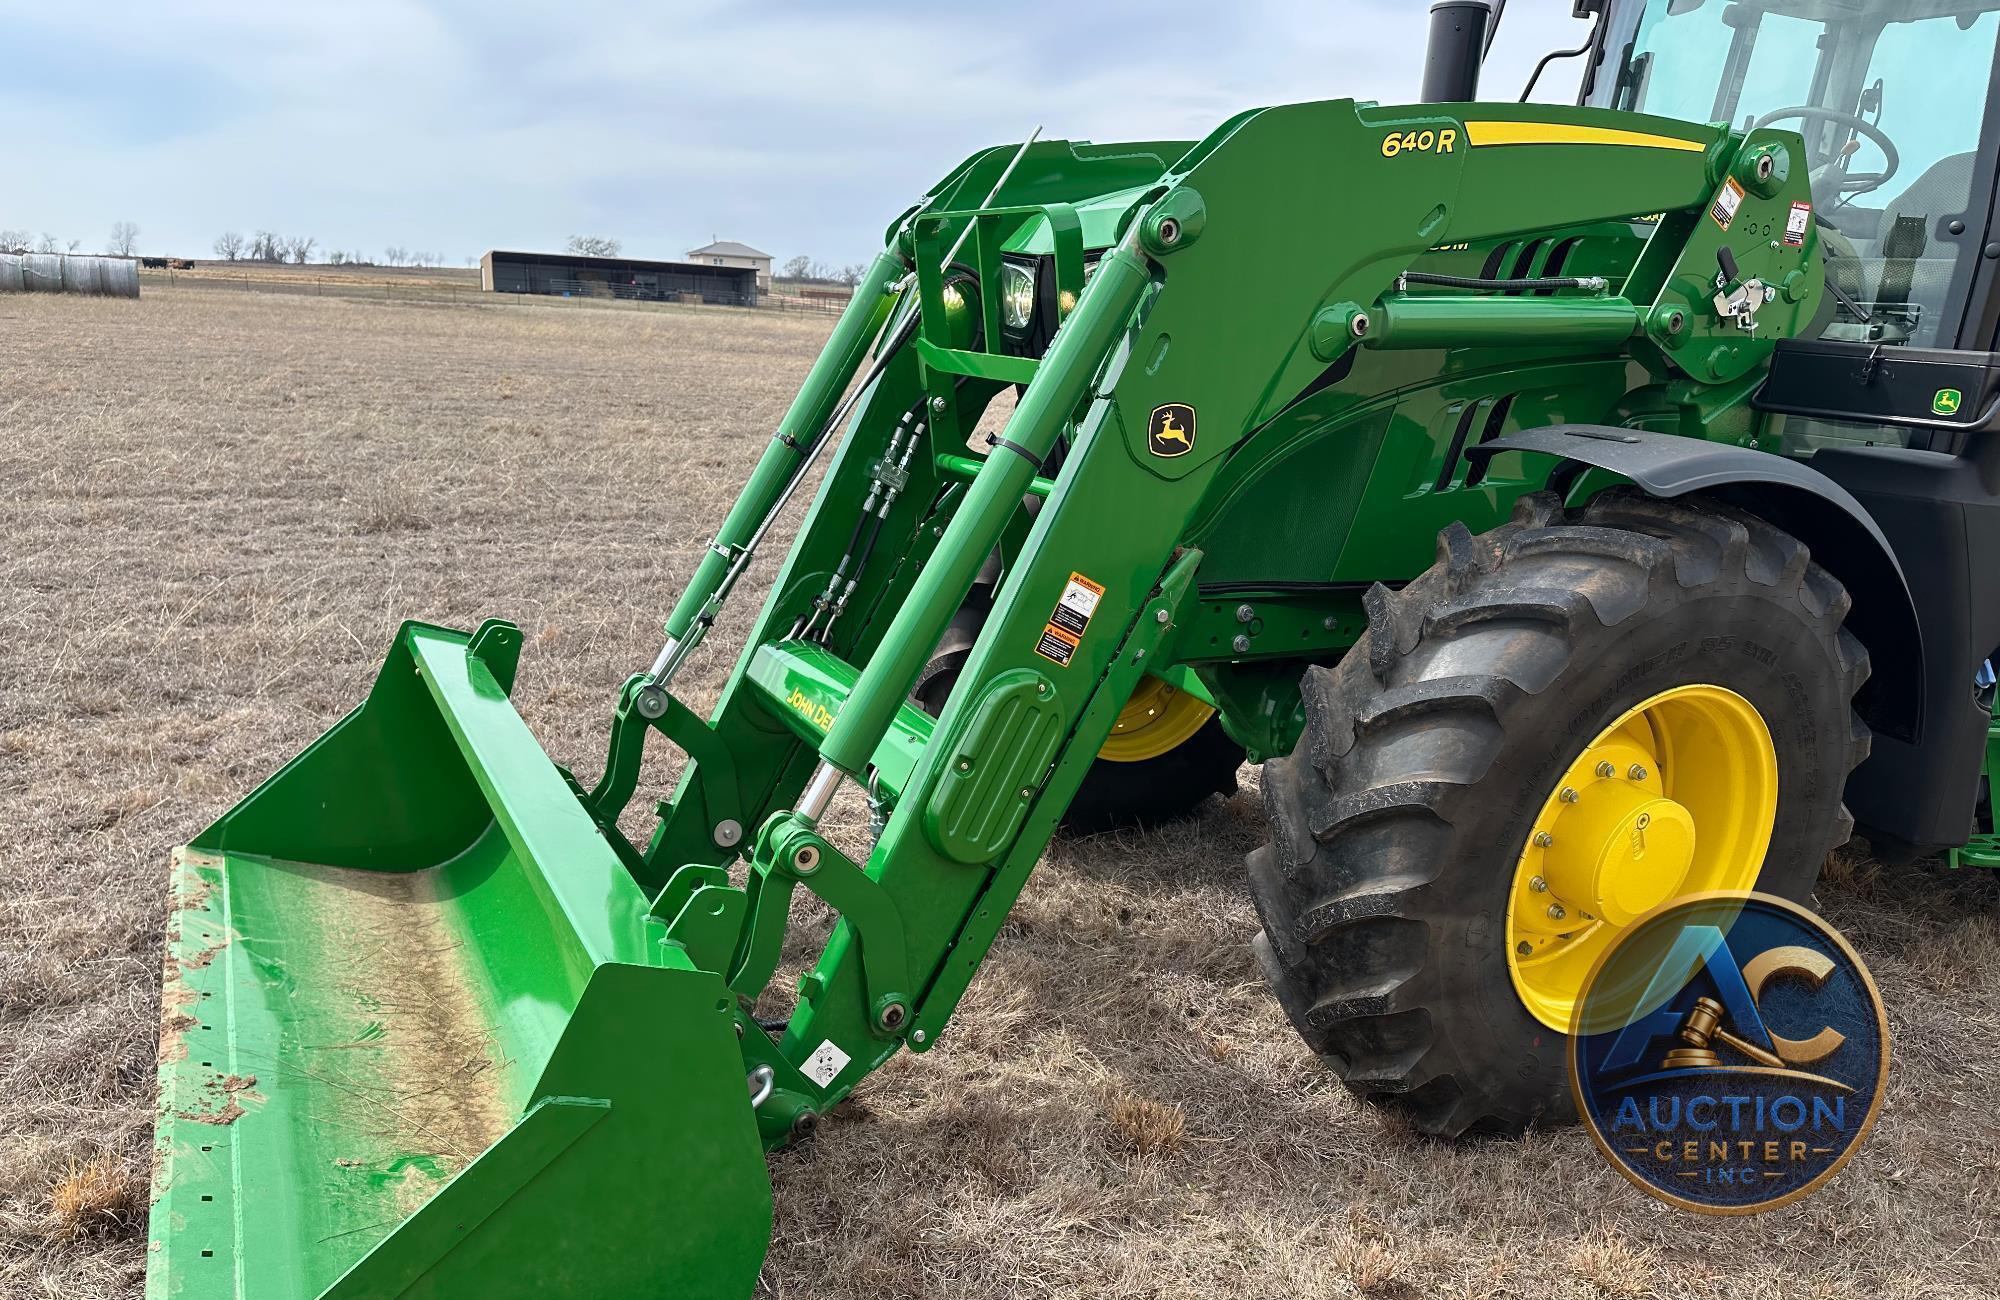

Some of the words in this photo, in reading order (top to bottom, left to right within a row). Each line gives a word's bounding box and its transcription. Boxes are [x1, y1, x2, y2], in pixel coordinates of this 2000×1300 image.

[1079, 576, 1101, 593] WARNING
[1053, 629, 1076, 645] WARNING
[786, 686, 817, 719] JOHN
